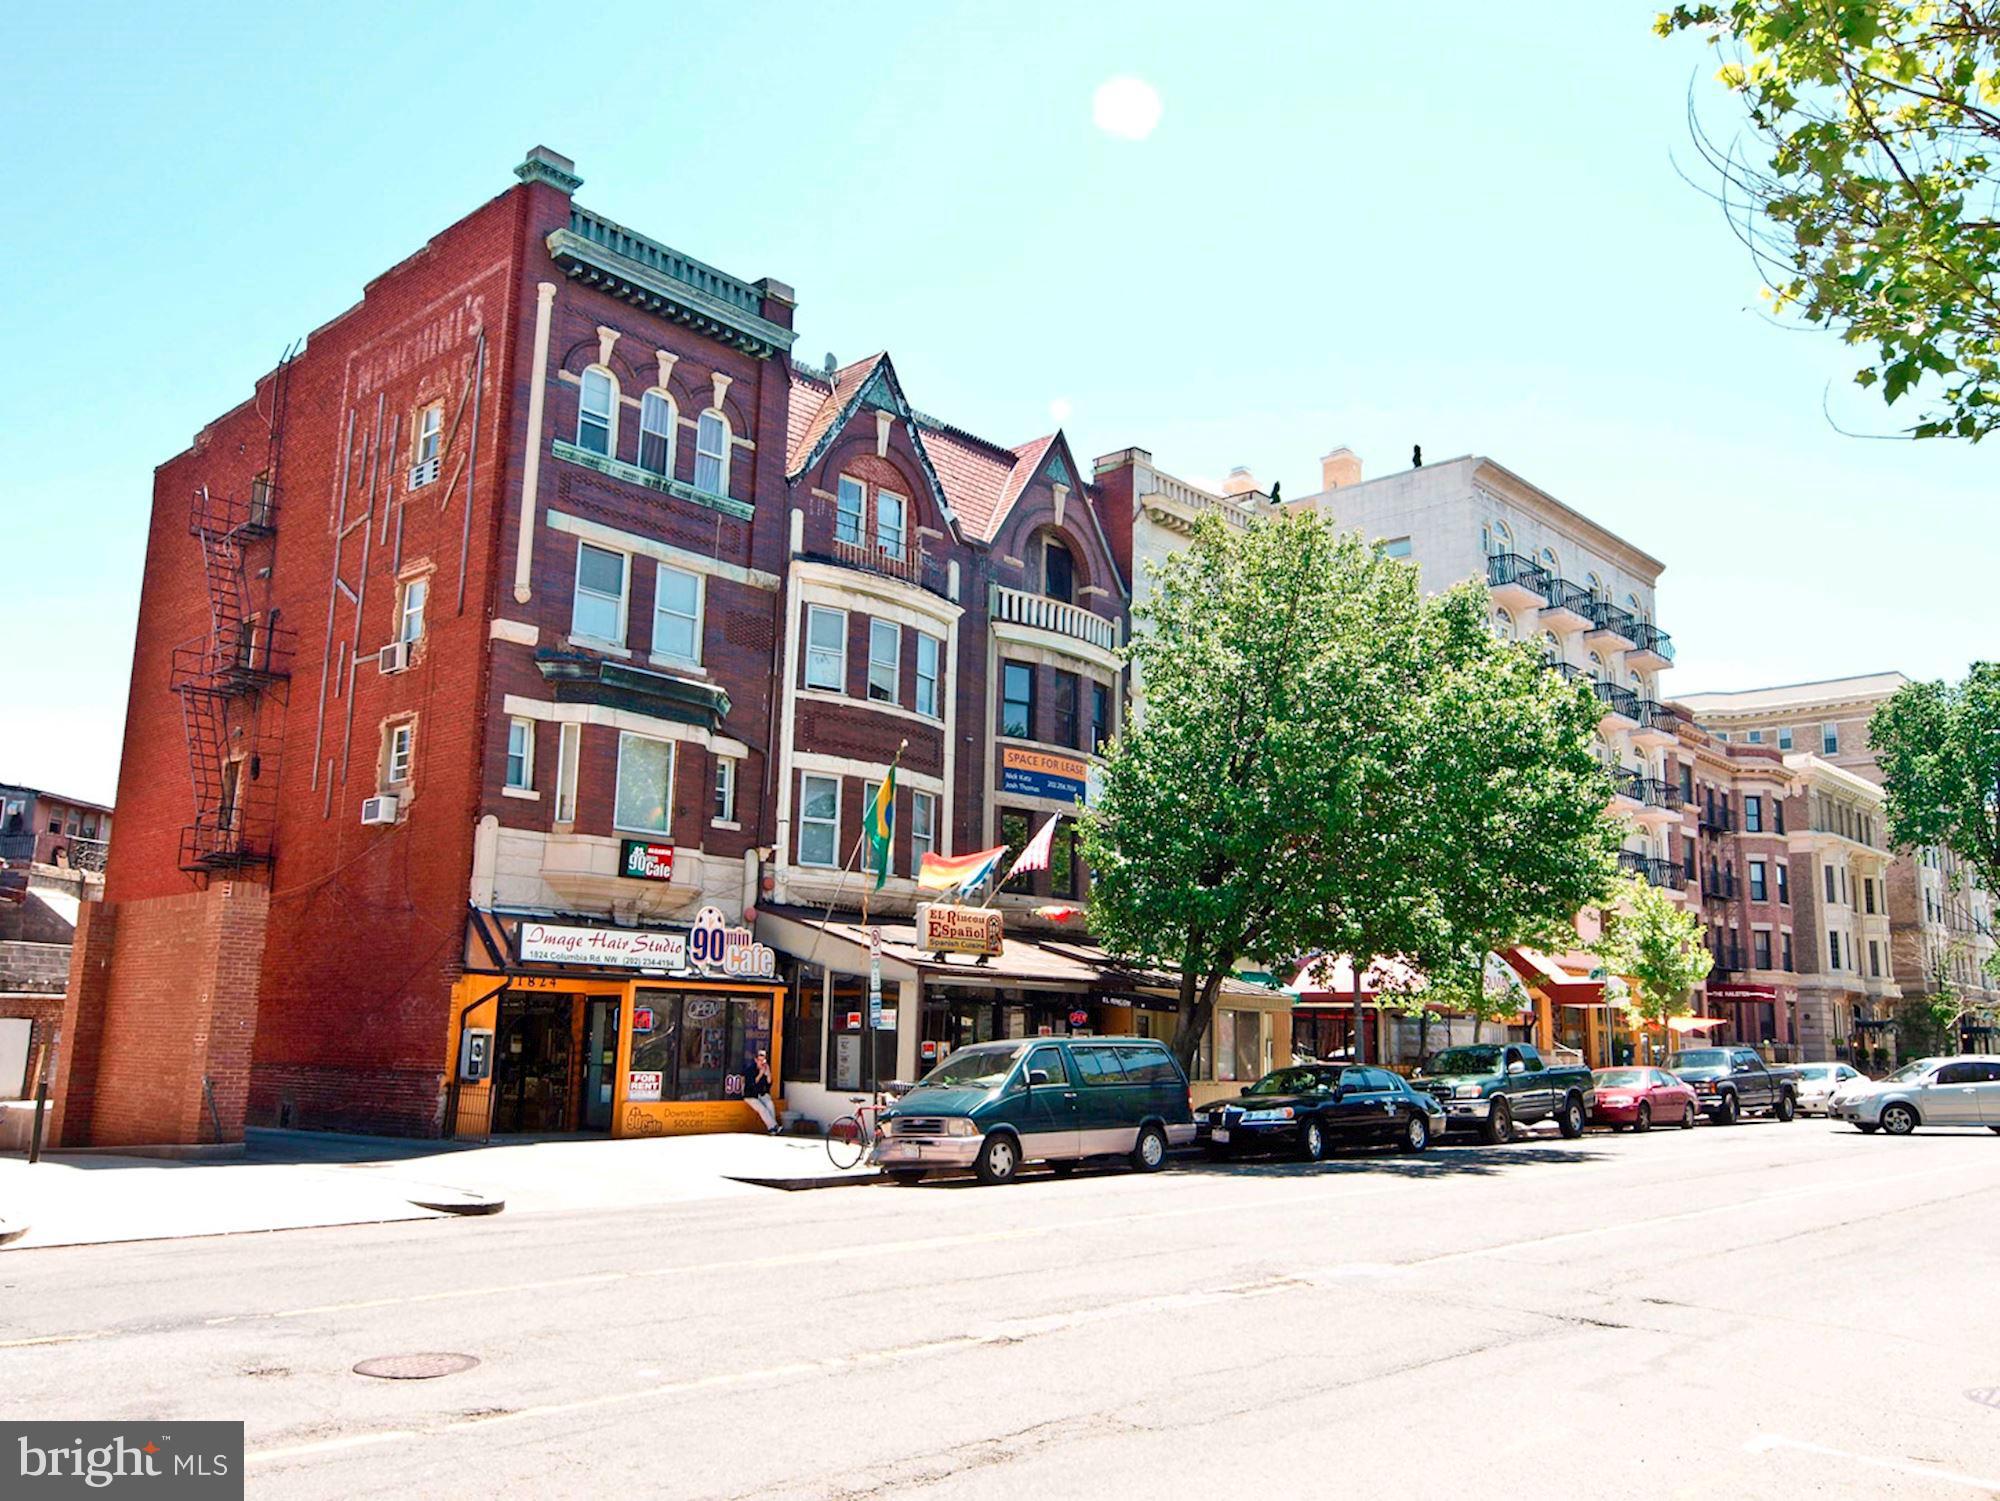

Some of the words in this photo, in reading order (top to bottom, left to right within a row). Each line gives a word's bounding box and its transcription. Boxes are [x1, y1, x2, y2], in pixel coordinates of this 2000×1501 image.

[1007, 752, 1039, 766] SPACE
[1041, 757, 1059, 769] FOR
[1061, 761, 1084, 775] LEASE
[628, 852, 647, 872] 90
[645, 861, 671, 878] Cafe
[930, 909, 945, 920] EL
[526, 926, 583, 951] Image
[588, 931, 629, 950] Hair
[630, 934, 682, 954] Studio
[692, 927, 725, 962] 90
[725, 927, 750, 946] min
[929, 939, 959, 947] Spanish
[960, 941, 985, 949] Cuisine
[530, 950, 548, 959] 1824
[550, 951, 588, 962] Columbia
[622, 957, 641, 966] (202)
[725, 943, 774, 975] Cafe
[517, 974, 557, 989] 1824
[1102, 996, 1110, 1004] EL
[690, 1001, 720, 1016] OPEN
[630, 1082, 659, 1090] RENT
[634, 1074, 656, 1082] FOR
[725, 1075, 742, 1093] 90
